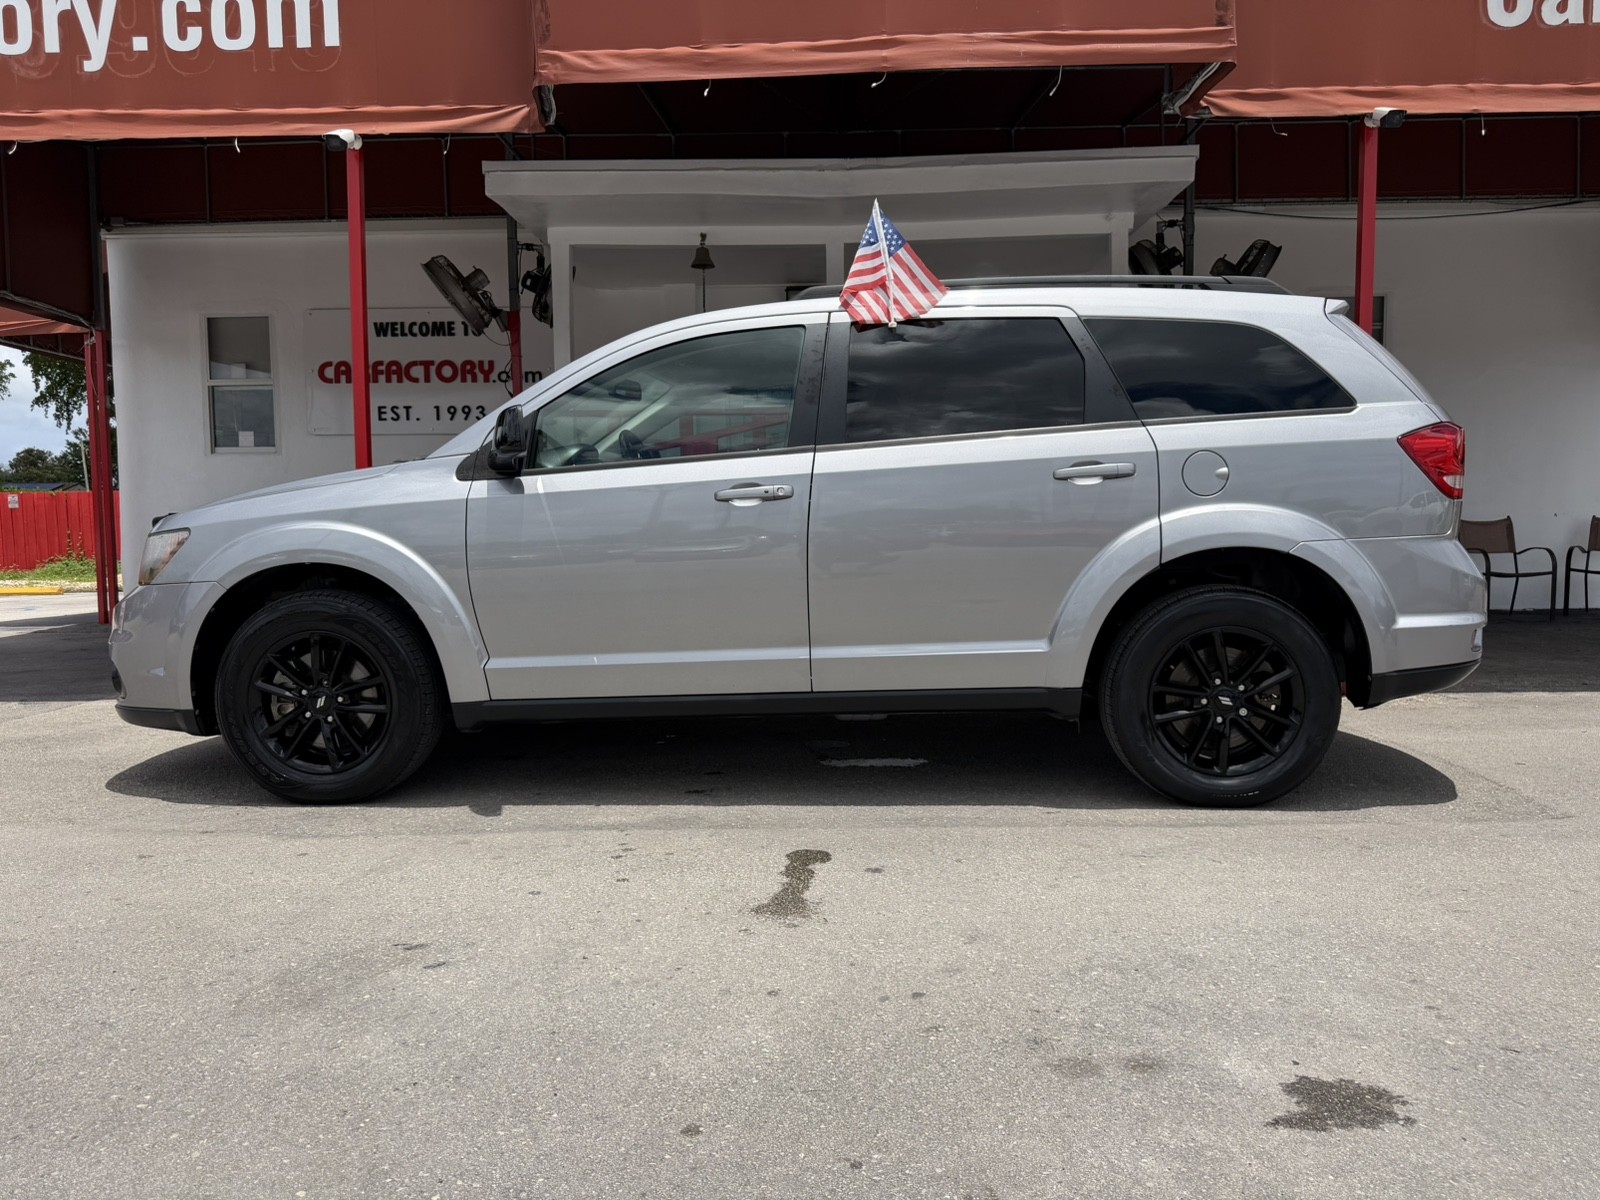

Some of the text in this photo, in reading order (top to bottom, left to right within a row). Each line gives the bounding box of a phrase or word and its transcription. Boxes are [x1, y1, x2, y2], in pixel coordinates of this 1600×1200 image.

[374, 321, 455, 337] WELCOME
[317, 360, 543, 384] CAFACTORY.cm
[377, 405, 487, 421] EST. 1993
